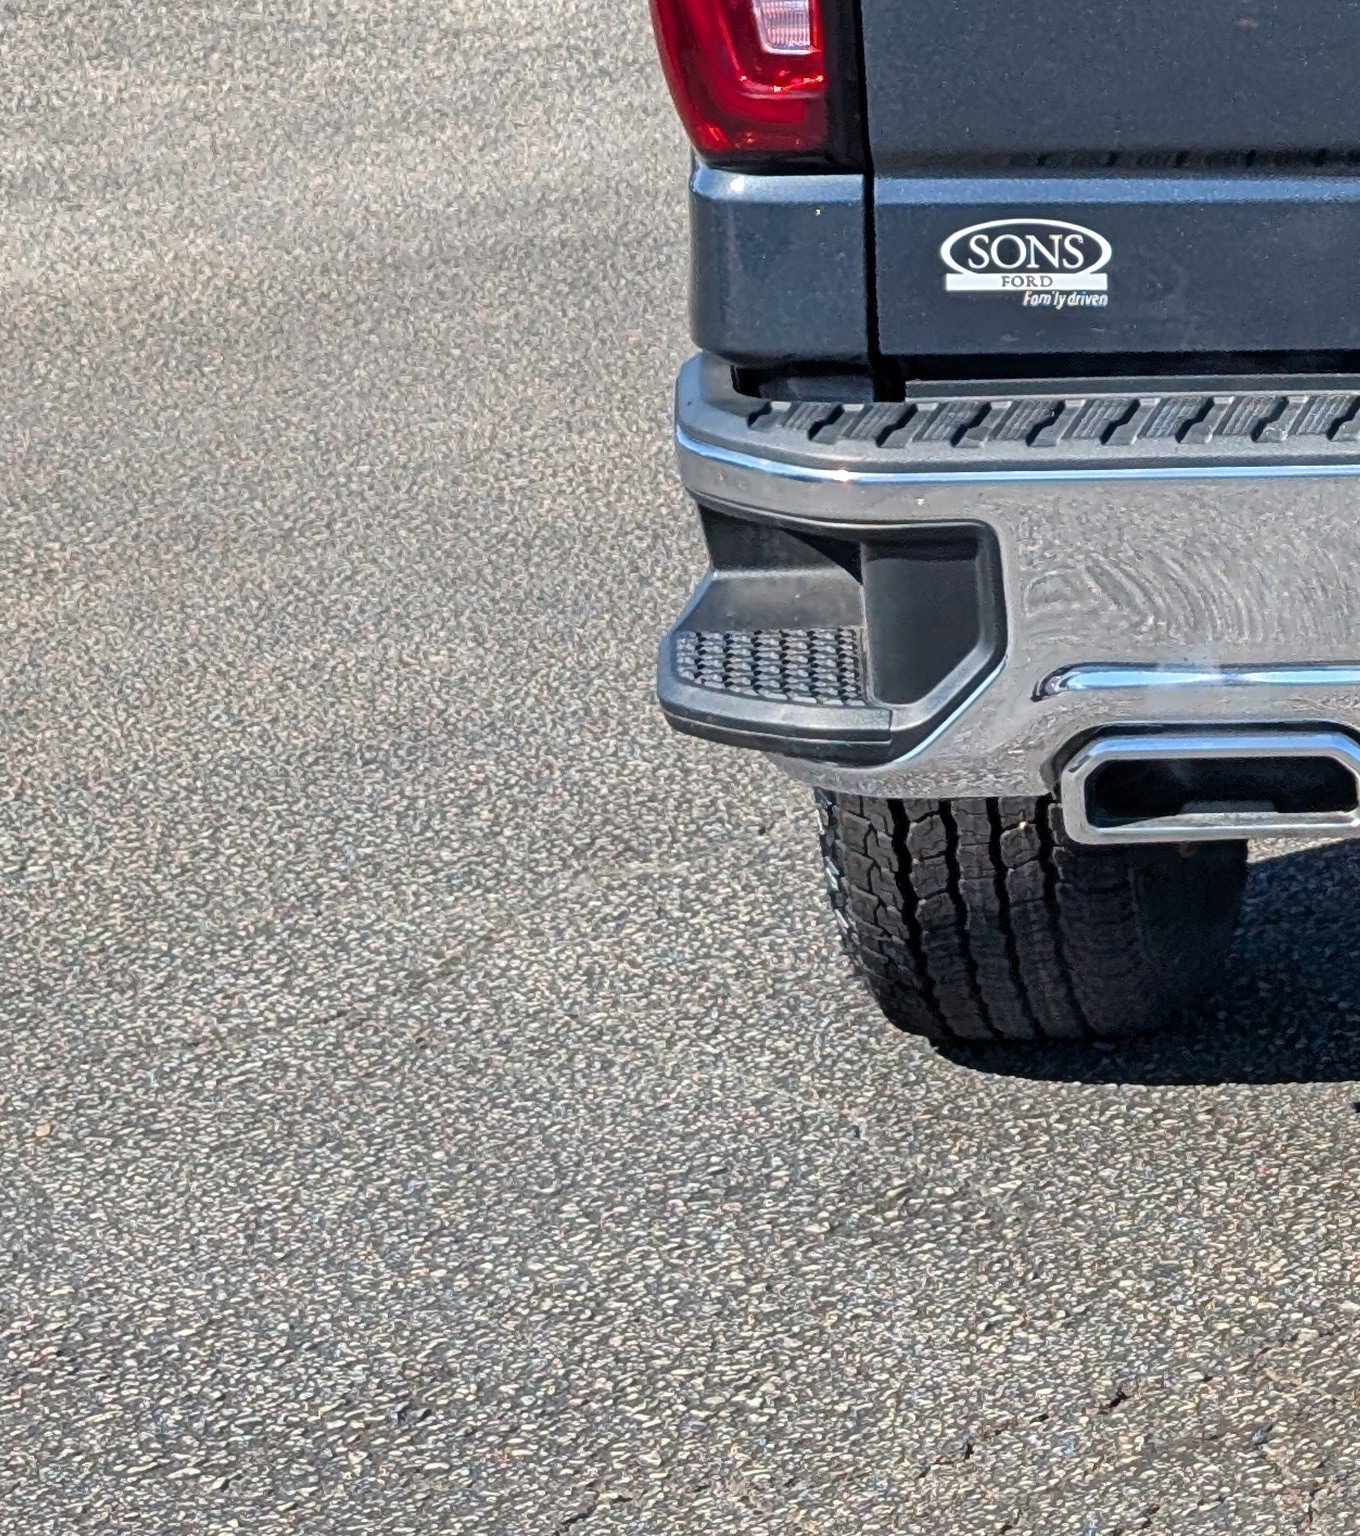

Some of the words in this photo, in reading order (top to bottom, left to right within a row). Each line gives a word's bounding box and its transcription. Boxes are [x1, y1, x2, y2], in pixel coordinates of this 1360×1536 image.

[967, 233, 1085, 270] SONS
[1001, 275, 1053, 287] FORD
[1023, 291, 1066, 309] Family
[1067, 291, 1108, 306] driven
